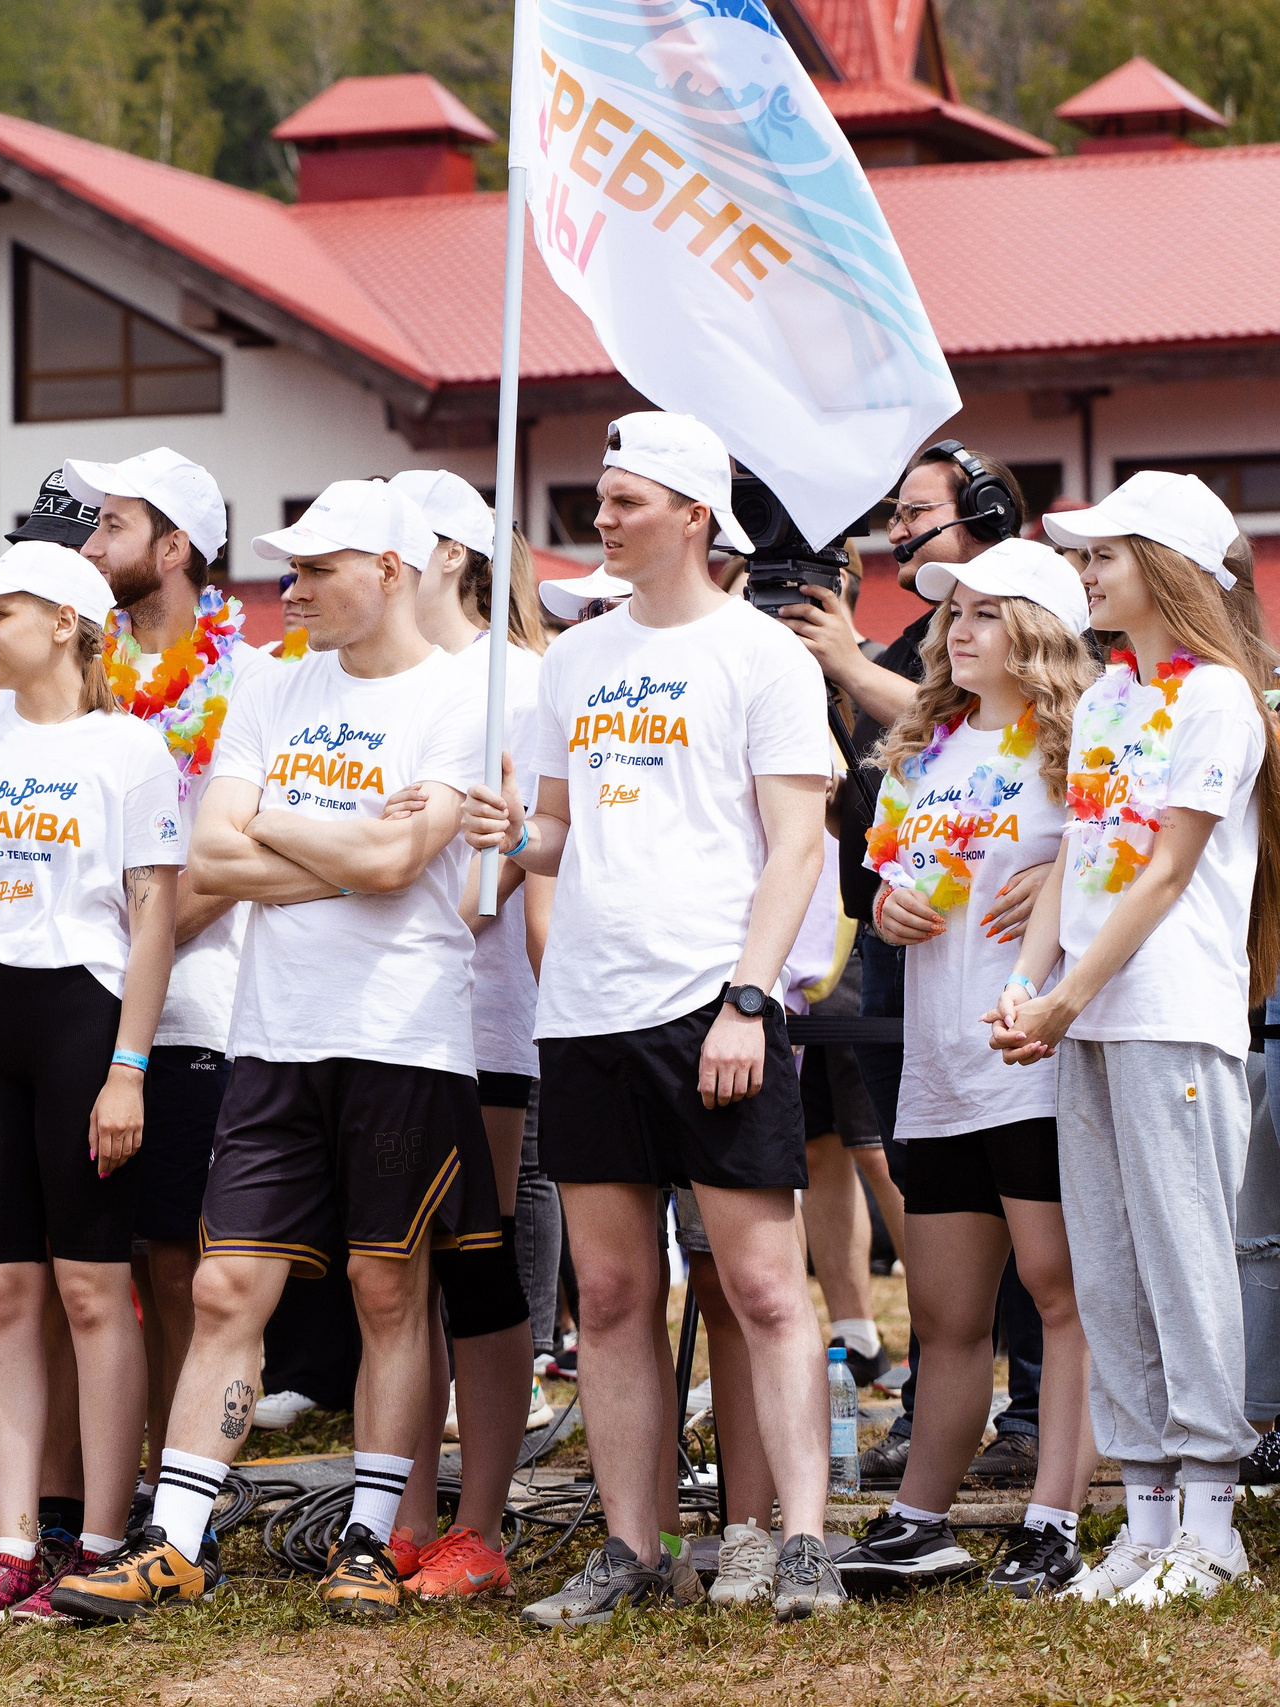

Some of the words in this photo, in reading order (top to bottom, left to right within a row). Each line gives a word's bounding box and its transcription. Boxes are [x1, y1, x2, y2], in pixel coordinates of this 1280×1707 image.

[33, 496, 73, 514] EA7
[587, 680, 633, 707] Лови
[627, 676, 688, 708] Волну
[327, 723, 387, 751] Волну
[569, 706, 689, 752] ДРАЙВА
[266, 752, 385, 795] ДРАЙВА
[11, 777, 79, 806] Волну
[190, 1062, 217, 1071] SPORT
[375, 1126, 430, 1178] 28
[1138, 1493, 1176, 1502] Reebok
[1210, 1494, 1235, 1502] Reebo
[1208, 1563, 1233, 1582] PUMA
